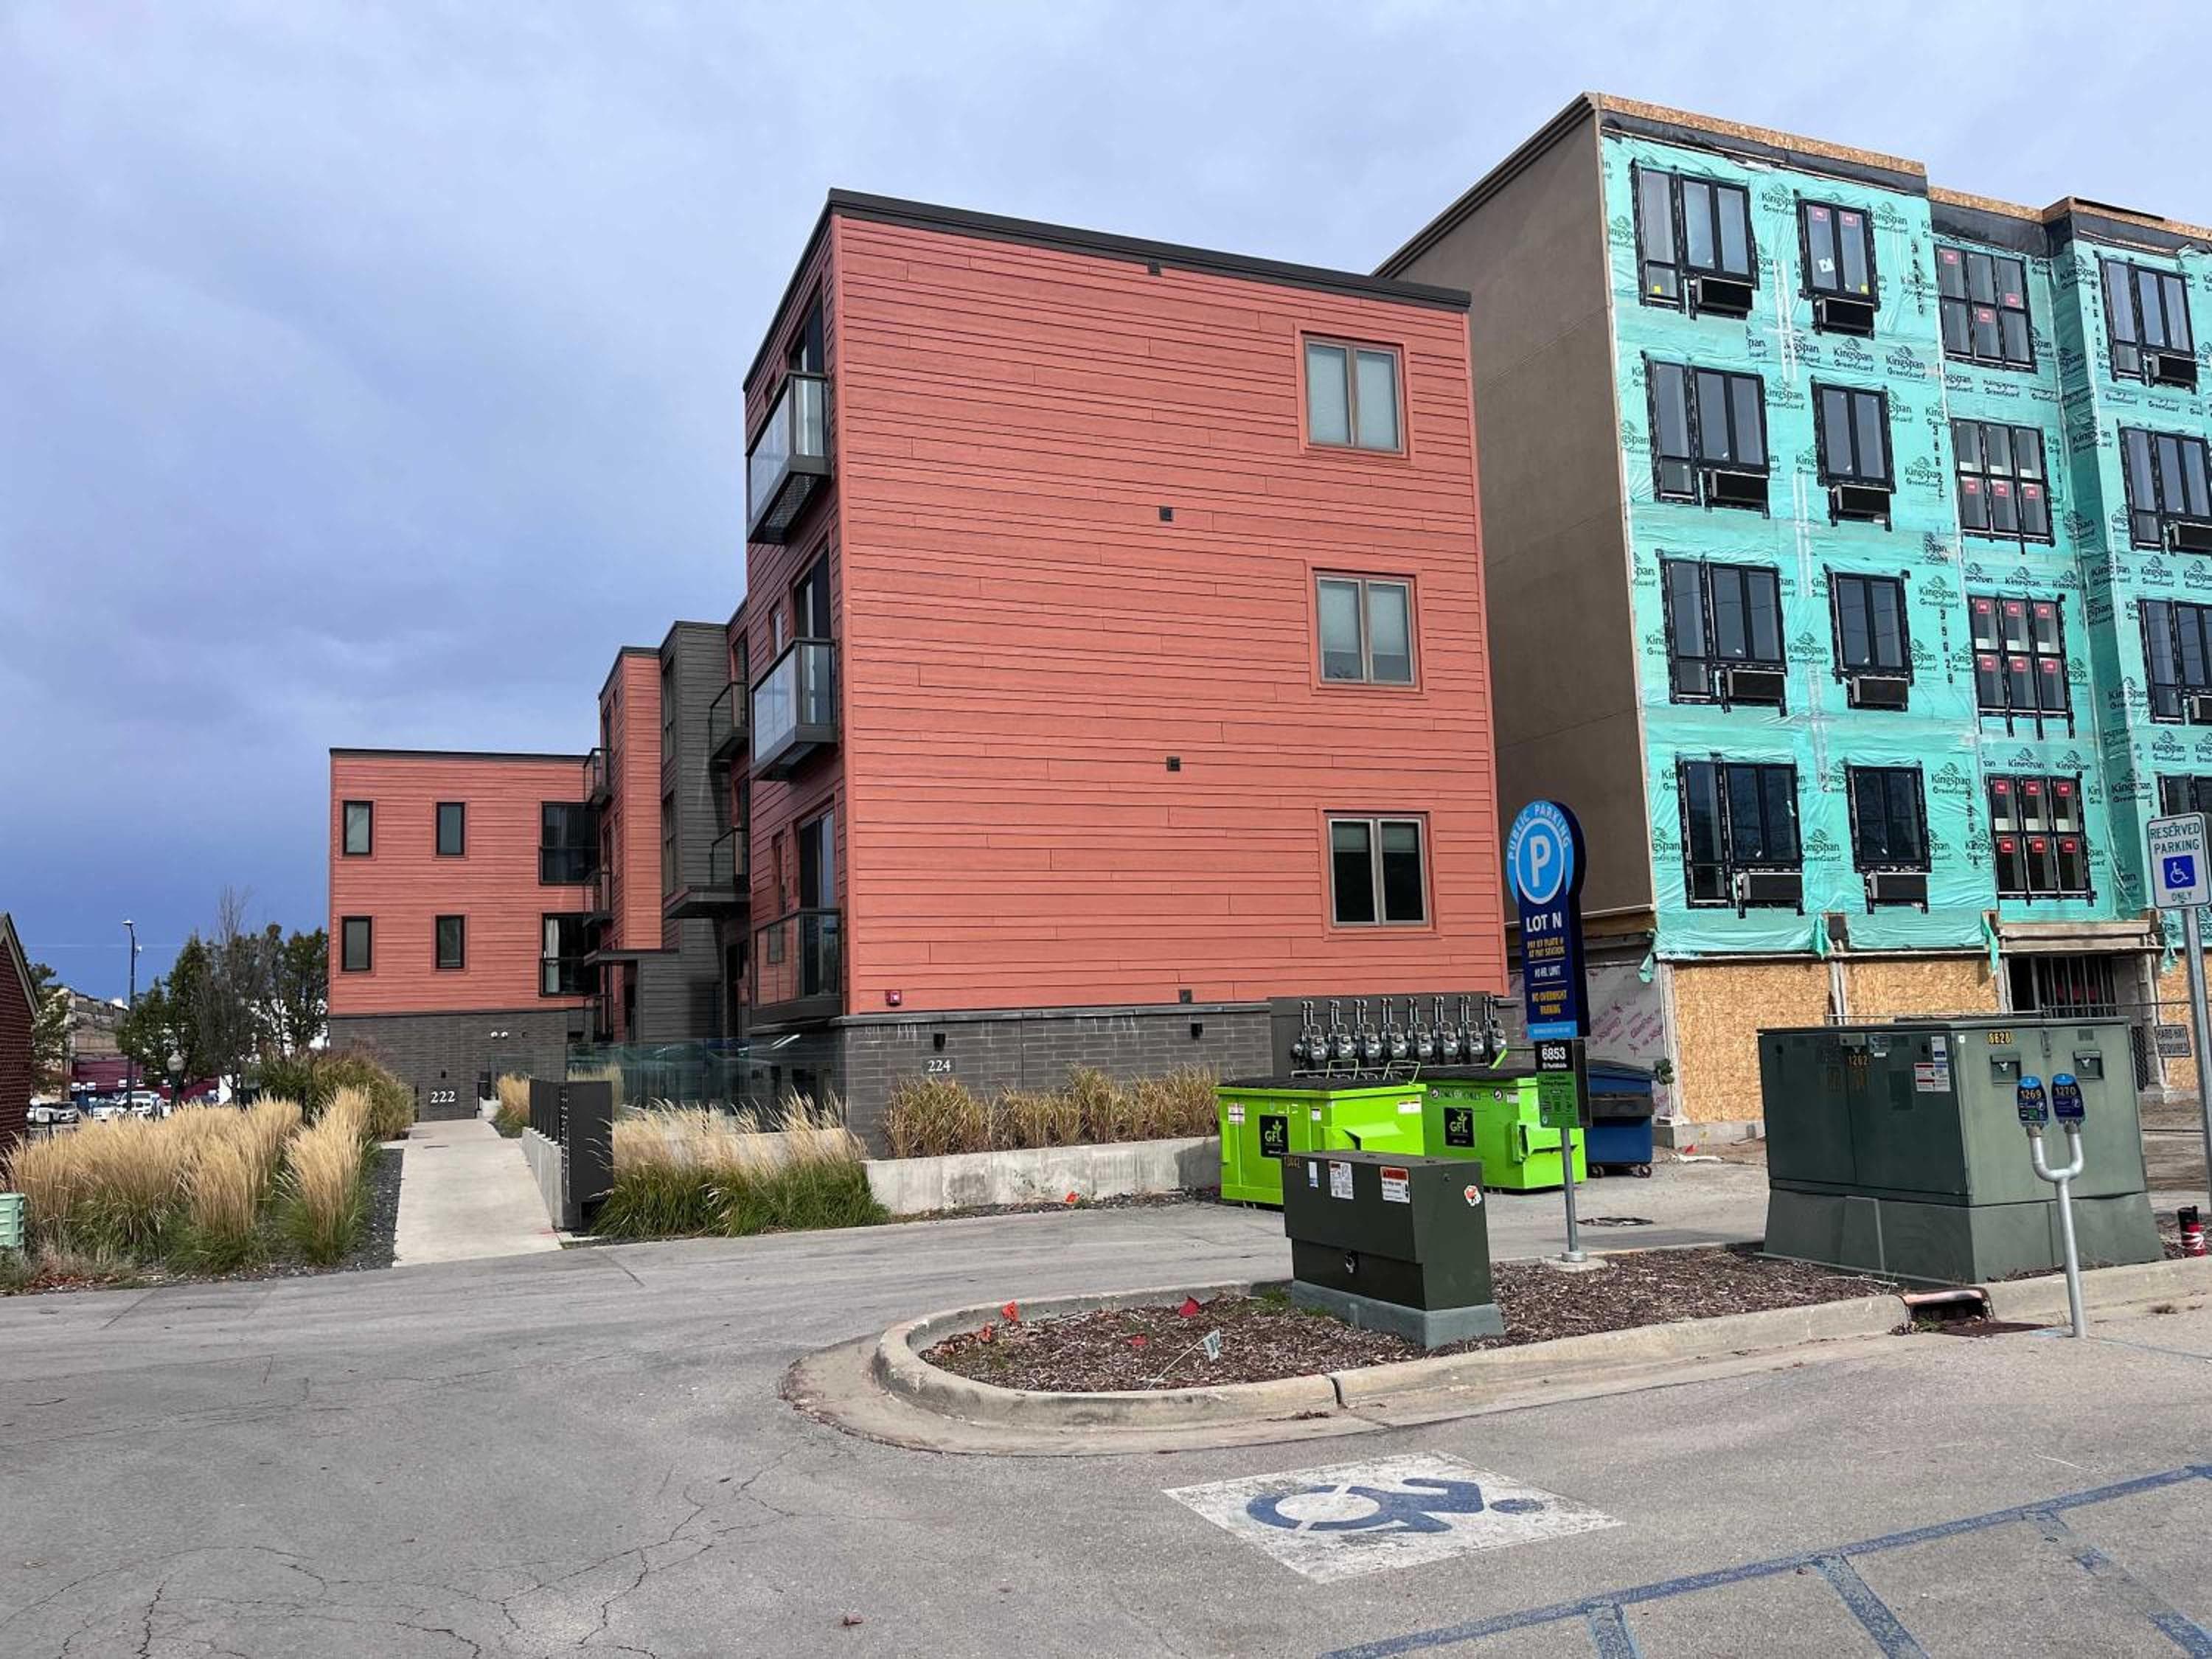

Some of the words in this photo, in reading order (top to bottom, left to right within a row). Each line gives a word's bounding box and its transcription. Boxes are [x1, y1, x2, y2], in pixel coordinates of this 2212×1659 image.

[1833, 347, 1874, 362] Kingspan
[1885, 355, 1925, 369] Kingspan
[1919, 585, 1959, 599] Kingspan
[1787, 642, 1828, 656] Kingspan
[1931, 773, 1971, 787] Kingspan
[1509, 811, 1531, 860] PUBLIC
[1534, 804, 1571, 849] PARKING
[2149, 822, 2201, 840] RESERVED
[2154, 838, 2200, 855] PARKING
[1529, 835, 1551, 888] P
[2171, 891, 2193, 902] ONLY
[1526, 914, 1548, 933] LOT
[1552, 911, 1563, 929] N
[1542, 1047, 1566, 1060] 6853
[927, 1059, 951, 1072] 224
[430, 1091, 456, 1104] 222
[1449, 1120, 1469, 1133] GFL
[1265, 1130, 1284, 1143] GFL
